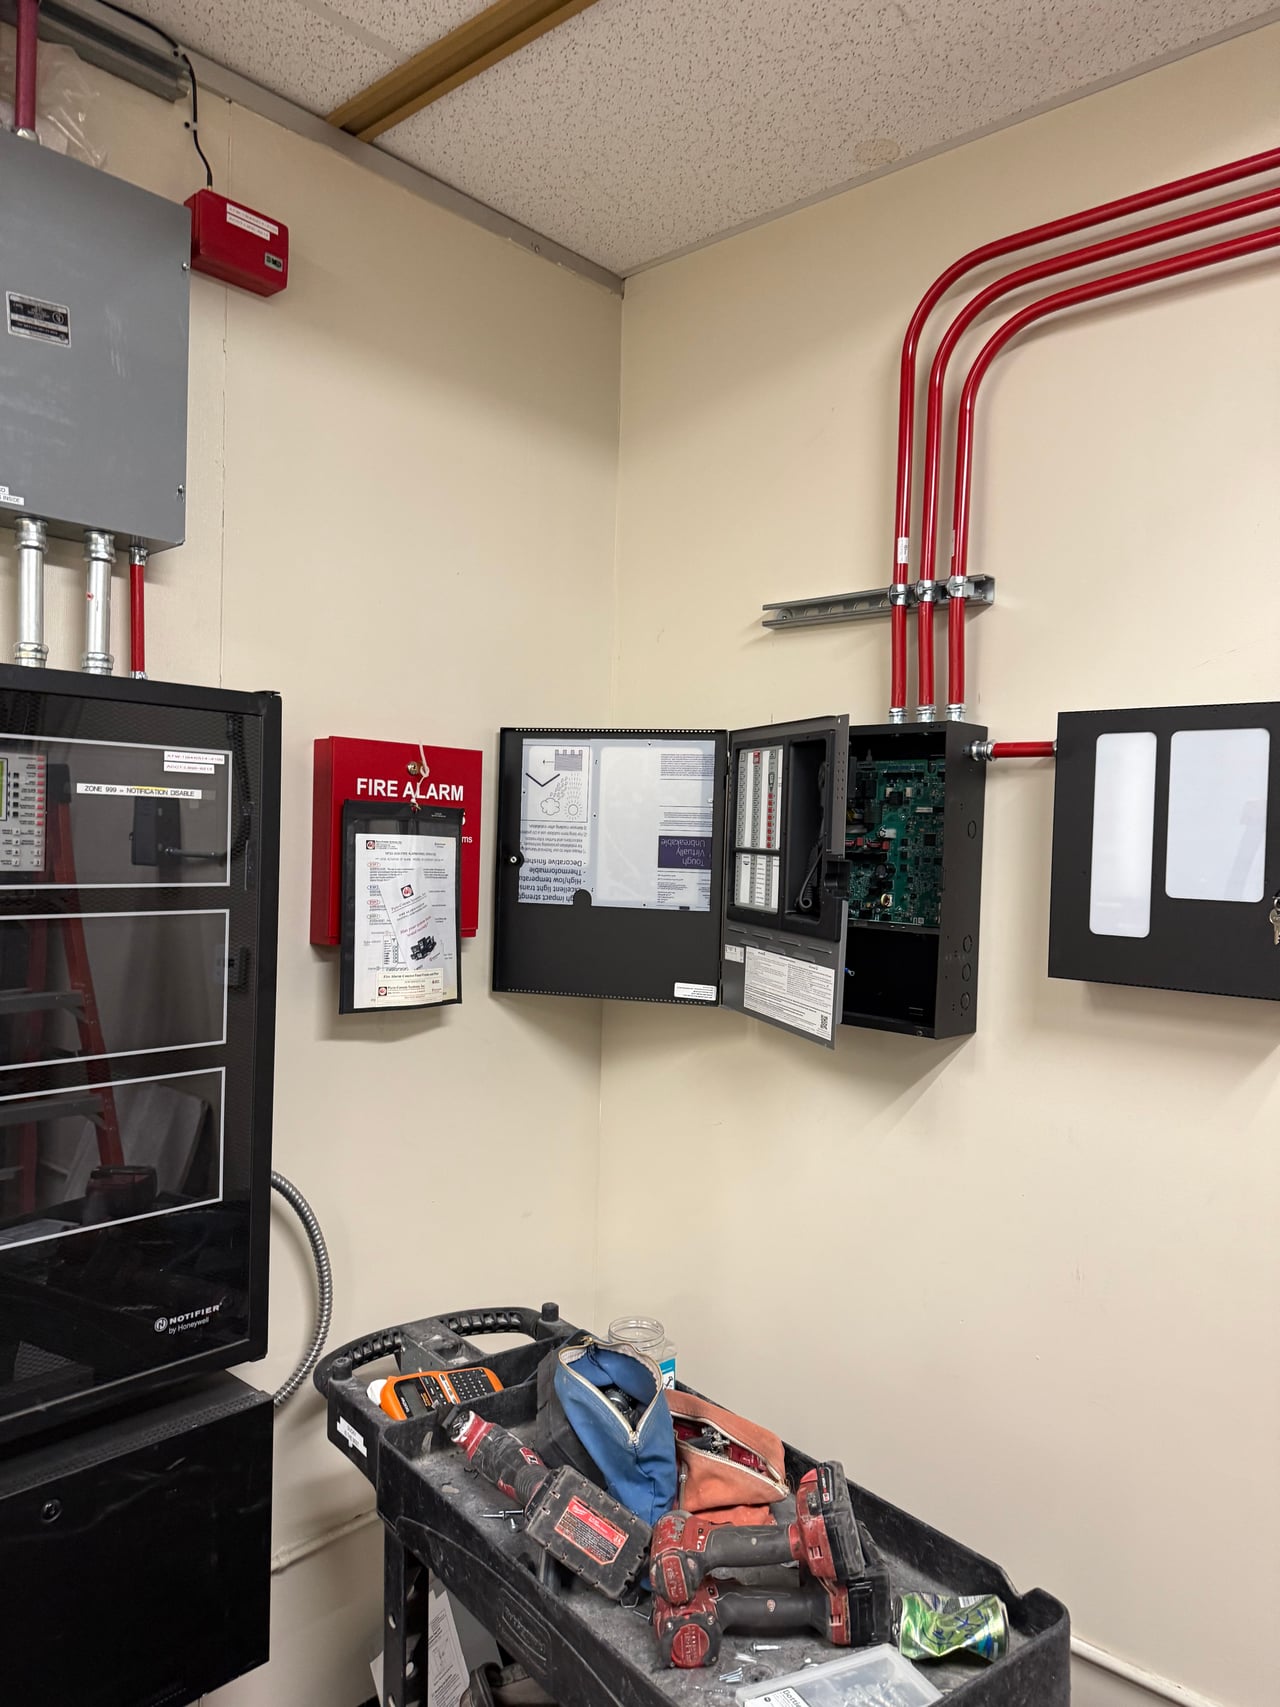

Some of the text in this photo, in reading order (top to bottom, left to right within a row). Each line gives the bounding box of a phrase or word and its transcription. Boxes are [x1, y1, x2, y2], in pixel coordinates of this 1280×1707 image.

[126, 787, 168, 796] NOTIFICATION
[357, 778, 463, 801] FIRE ALARM
[661, 839, 705, 847] Unbreakable
[676, 847, 705, 857] Virtually
[682, 857, 704, 867] Tough
[170, 1305, 220, 1324] NOTIFIER
[178, 1317, 210, 1331] Honeywell
